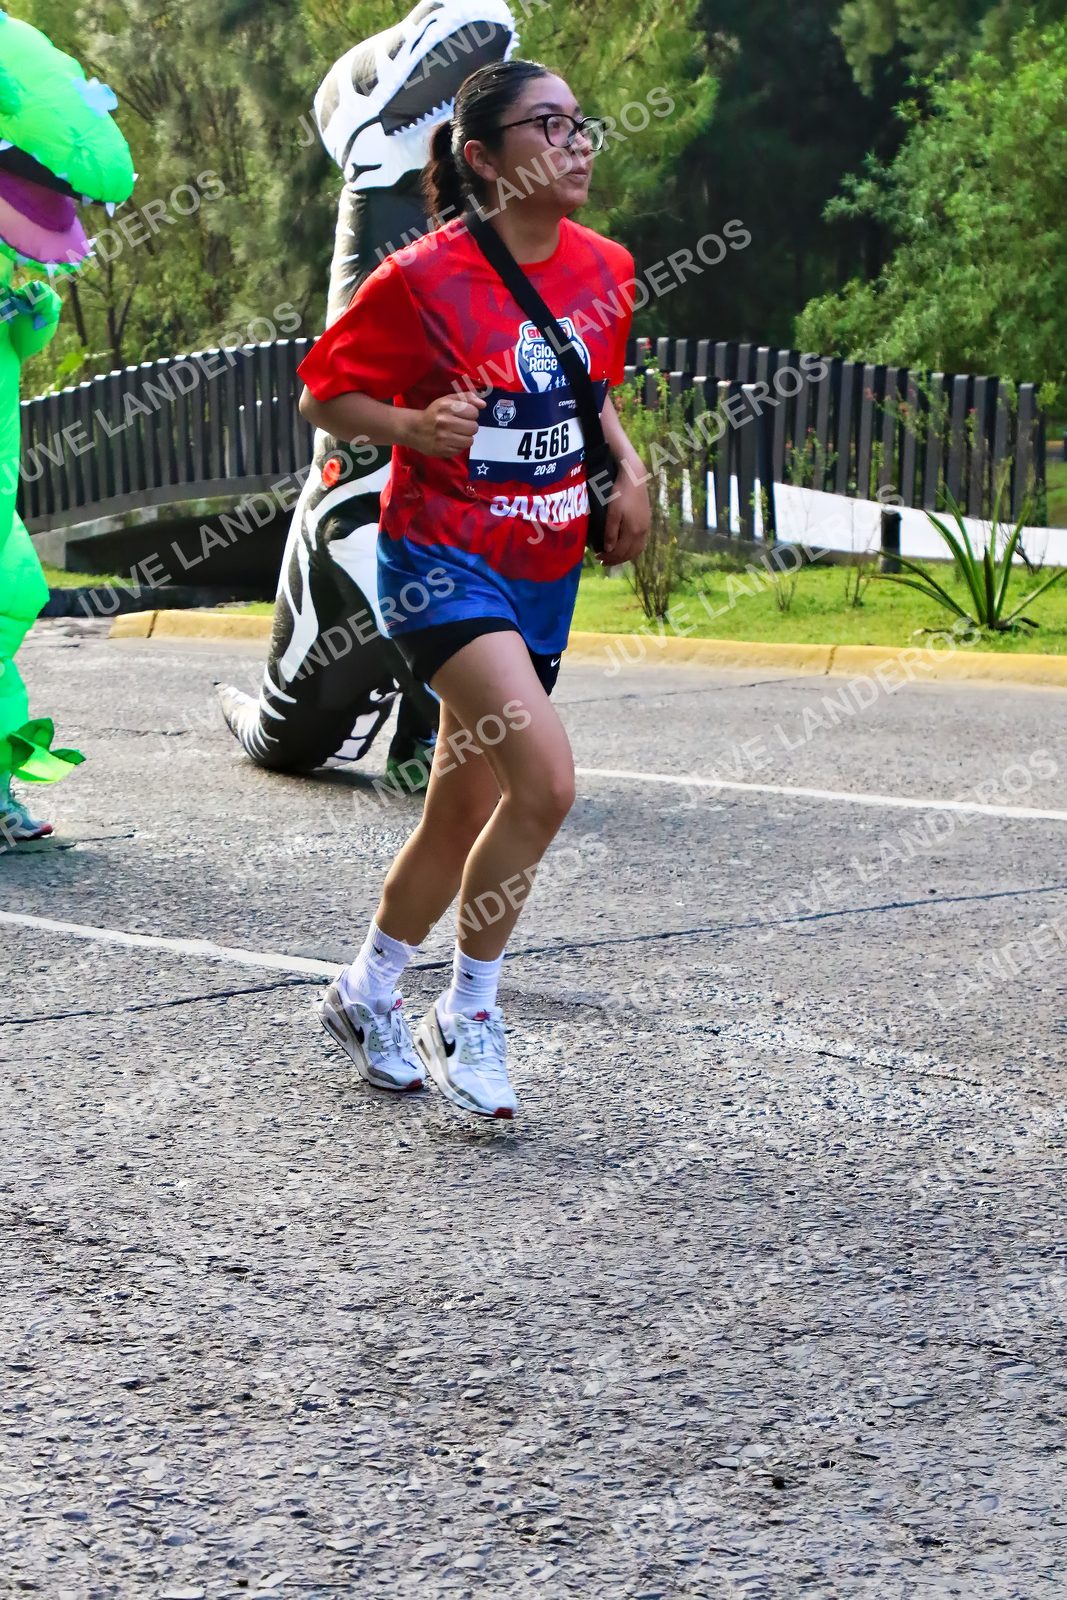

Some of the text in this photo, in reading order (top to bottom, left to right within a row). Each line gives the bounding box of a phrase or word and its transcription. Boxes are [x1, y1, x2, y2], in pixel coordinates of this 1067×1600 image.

[533, 343, 557, 359] Glo
[529, 357, 558, 372] Race
[517, 423, 569, 460] 4566
